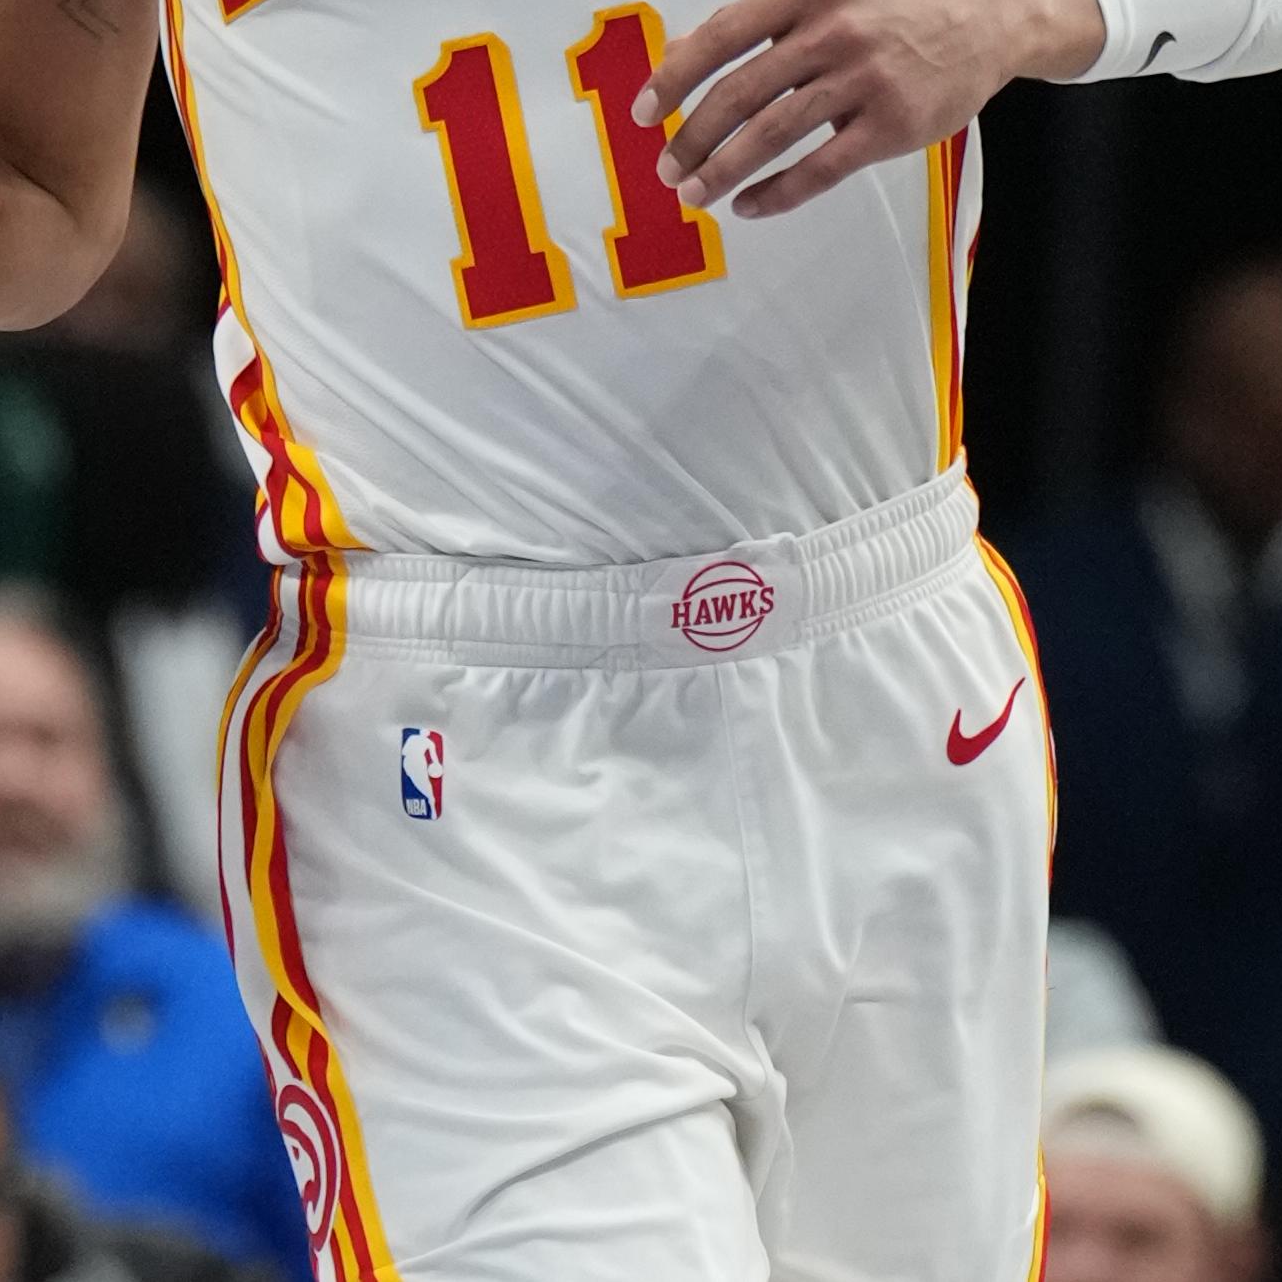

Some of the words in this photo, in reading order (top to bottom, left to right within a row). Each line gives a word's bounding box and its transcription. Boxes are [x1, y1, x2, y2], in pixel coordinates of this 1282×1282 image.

[412, 1, 728, 330] 11
[671, 586, 774, 628] HAWKS
[406, 798, 427, 816] NBA
